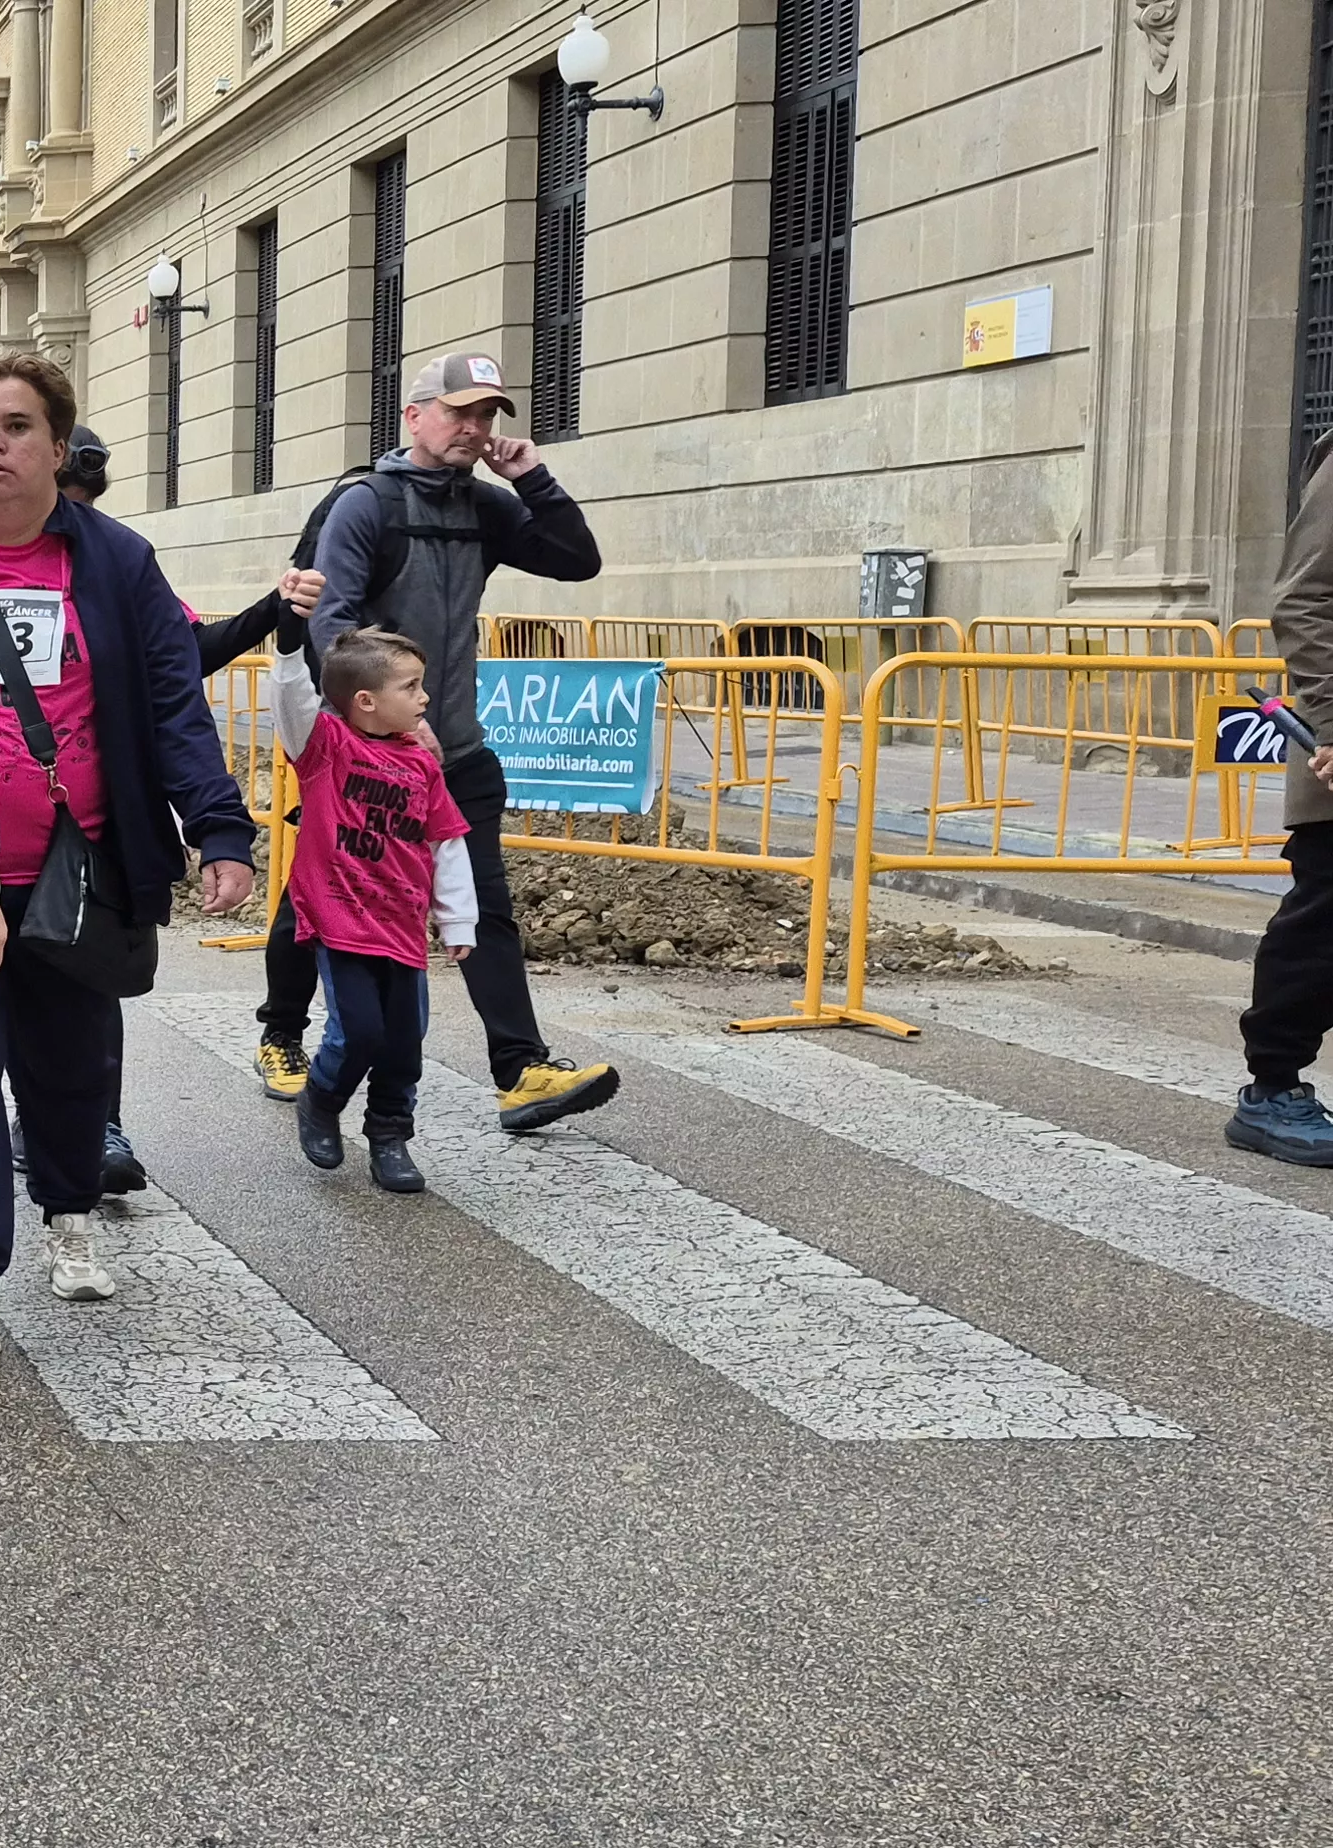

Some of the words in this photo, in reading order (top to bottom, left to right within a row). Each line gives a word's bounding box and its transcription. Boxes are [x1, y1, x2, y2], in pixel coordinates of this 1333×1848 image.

[7, 605, 52, 617] CÁNCER
[477, 674, 644, 725] ARLAN
[519, 726, 637, 748] INMOBILIARIOS
[498, 752, 634, 774] aninmobiliaria.com
[343, 772, 411, 813] UNIDOS
[365, 806, 388, 835] EN
[336, 824, 385, 863] PASO
